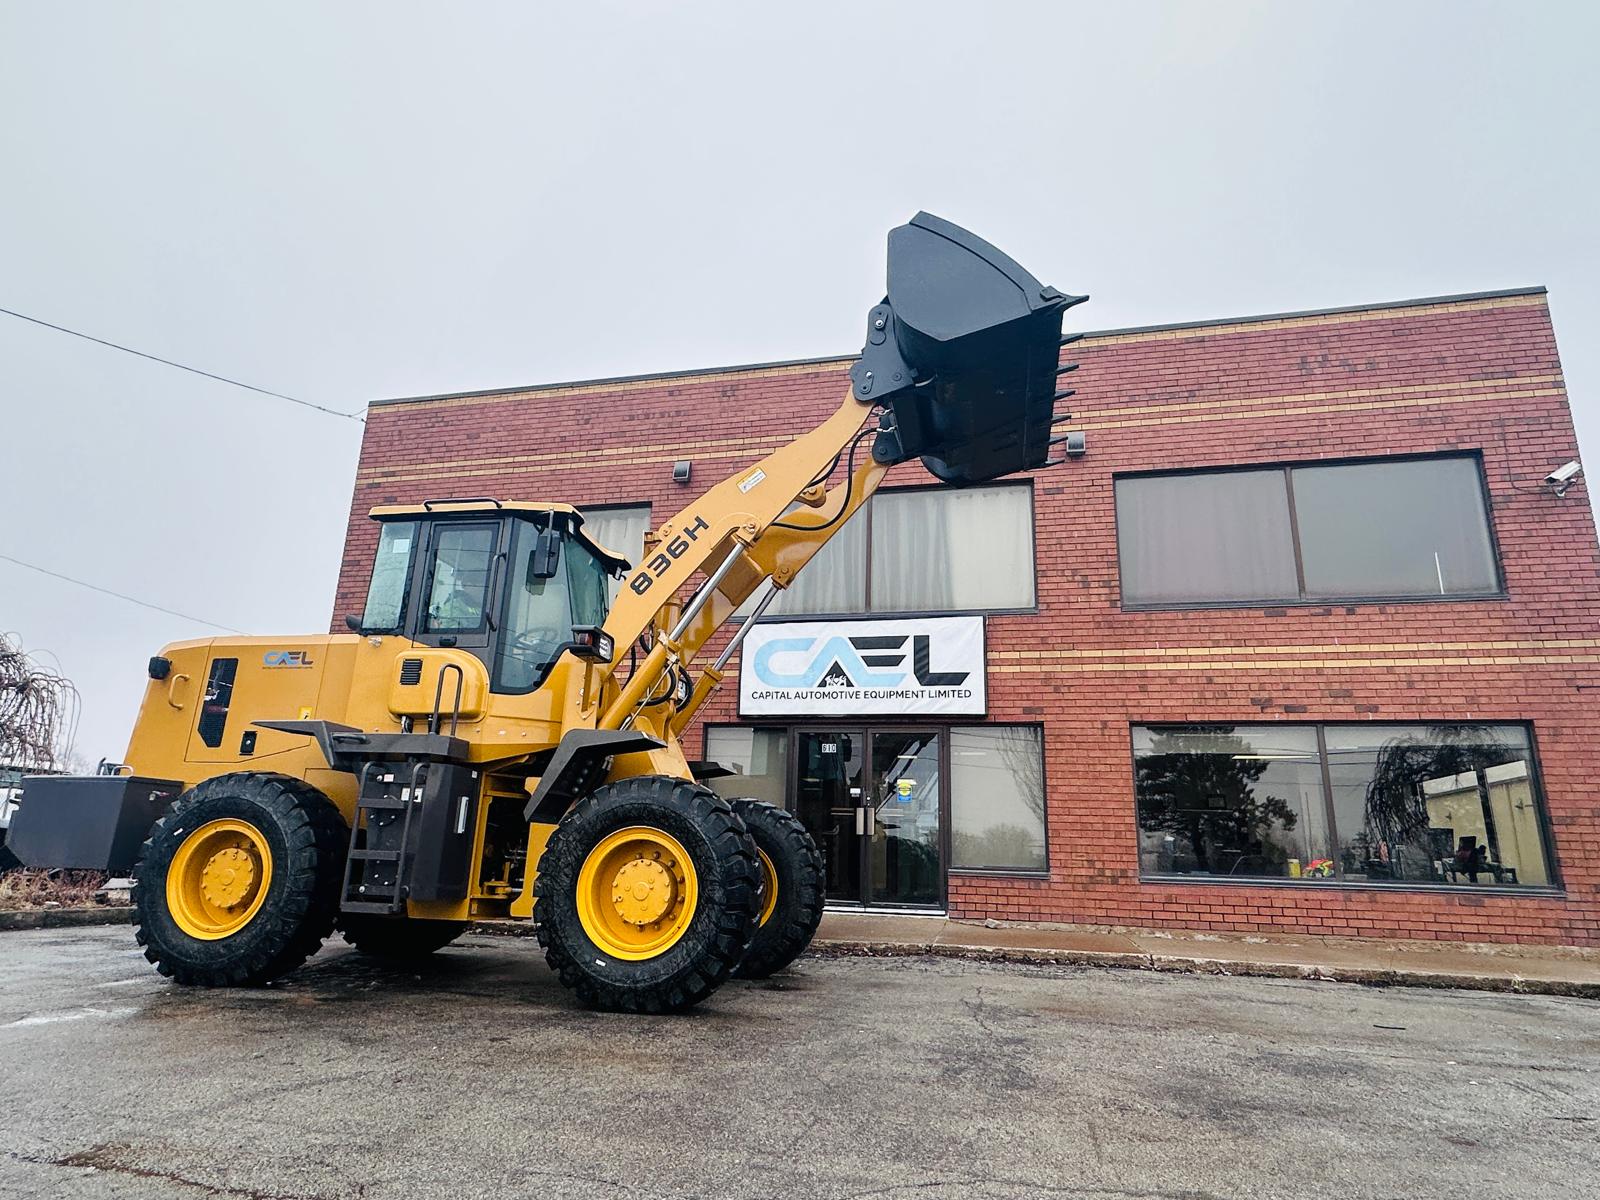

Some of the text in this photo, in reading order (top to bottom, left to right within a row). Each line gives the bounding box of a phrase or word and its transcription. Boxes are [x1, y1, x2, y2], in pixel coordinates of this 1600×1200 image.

[630, 515, 710, 596] 836H
[263, 651, 314, 665] CAEL
[753, 634, 971, 688] CAEL
[752, 689, 972, 700] CAPITAL AUTOMOTIVE EQUIPMENT LIMITED
[822, 744, 836, 752] 610
